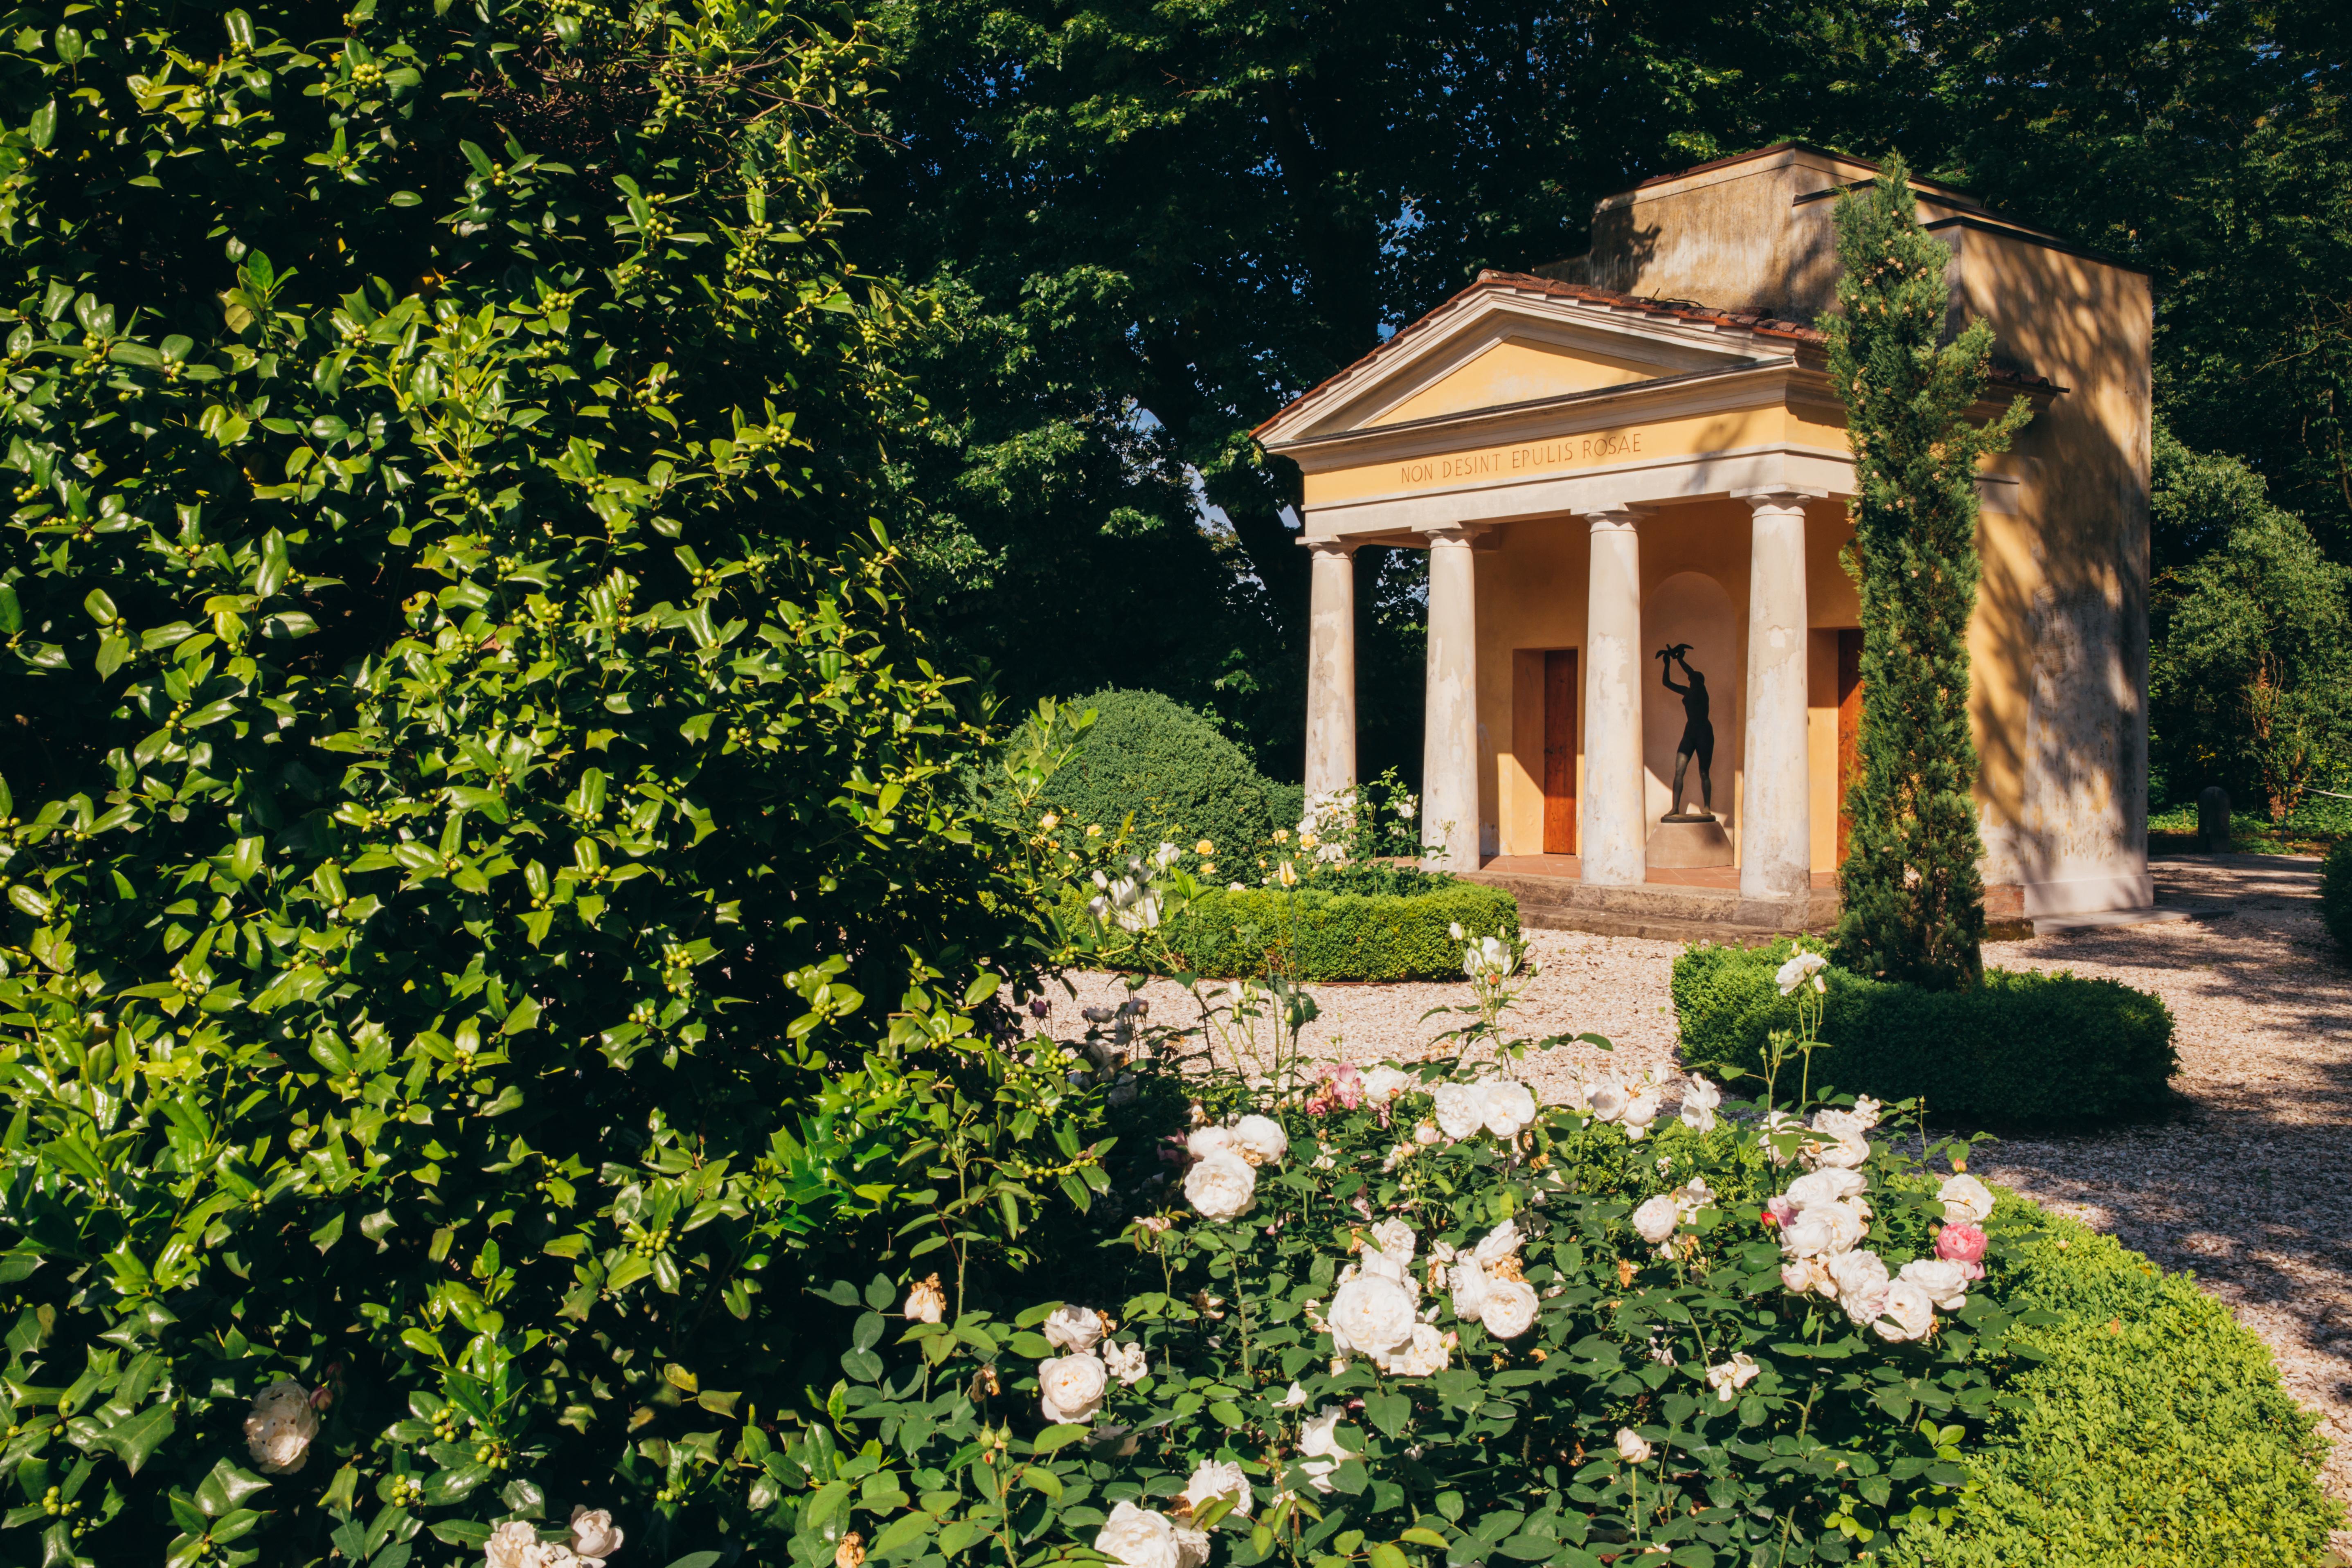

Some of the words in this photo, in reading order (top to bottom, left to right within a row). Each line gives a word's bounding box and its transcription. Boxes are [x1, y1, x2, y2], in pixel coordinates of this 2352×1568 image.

[1401, 463, 1432, 483] NON
[1443, 454, 1501, 478] DESINT
[1512, 442, 1573, 468] EPULIS
[1582, 433, 1641, 459] ROSAE
